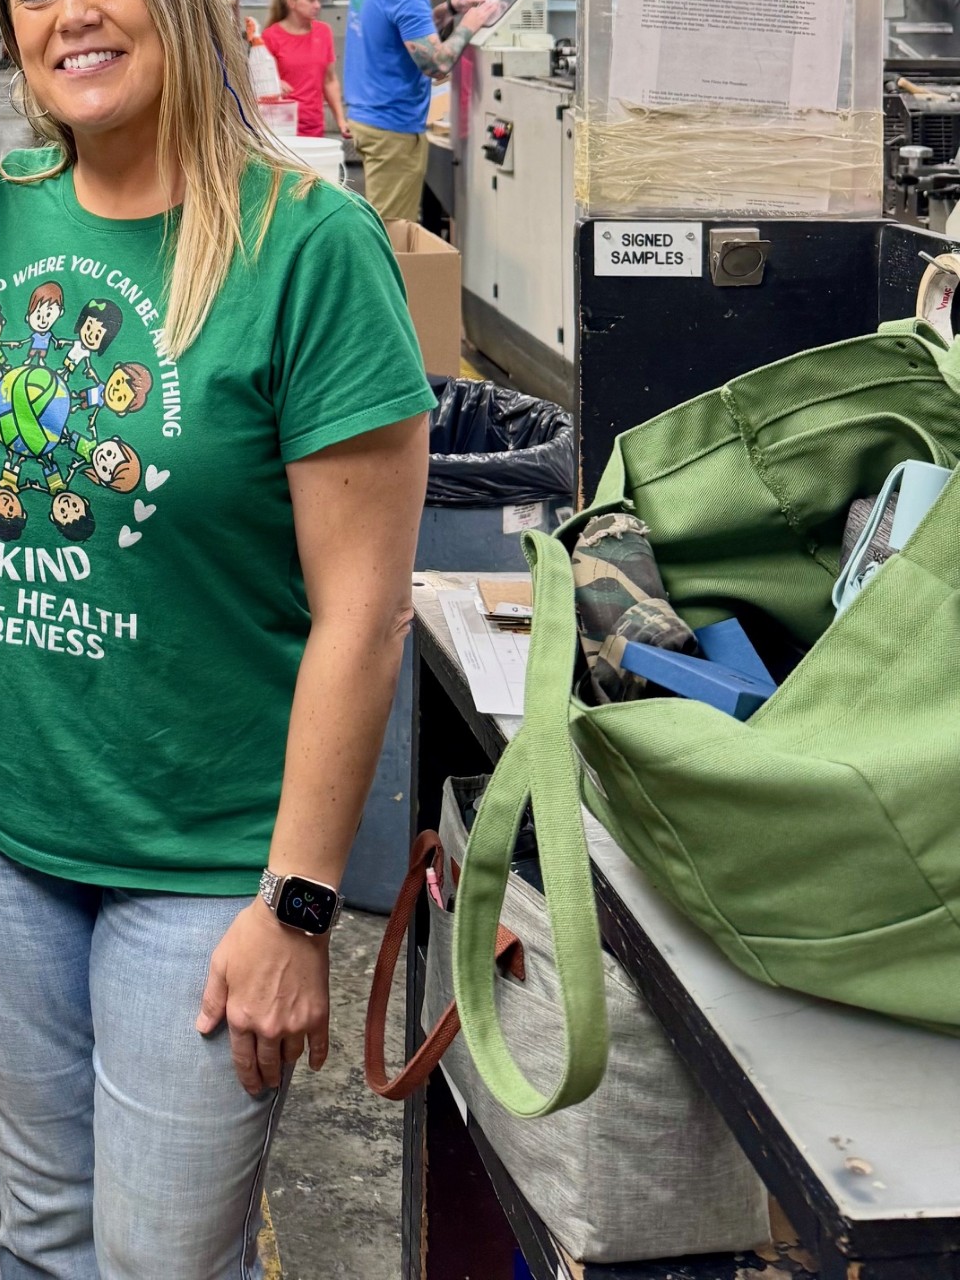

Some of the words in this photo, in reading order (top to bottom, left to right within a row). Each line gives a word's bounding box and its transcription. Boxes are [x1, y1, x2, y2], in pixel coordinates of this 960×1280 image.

[621, 233, 673, 247] SIGNED
[611, 251, 684, 265] SAMPLES
[12, 255, 66, 287] WHERE
[70, 255, 107, 280] YOU
[106, 269, 143, 305] CAN
[134, 297, 160, 327] BE
[17, 588, 137, 640] HEALTH
